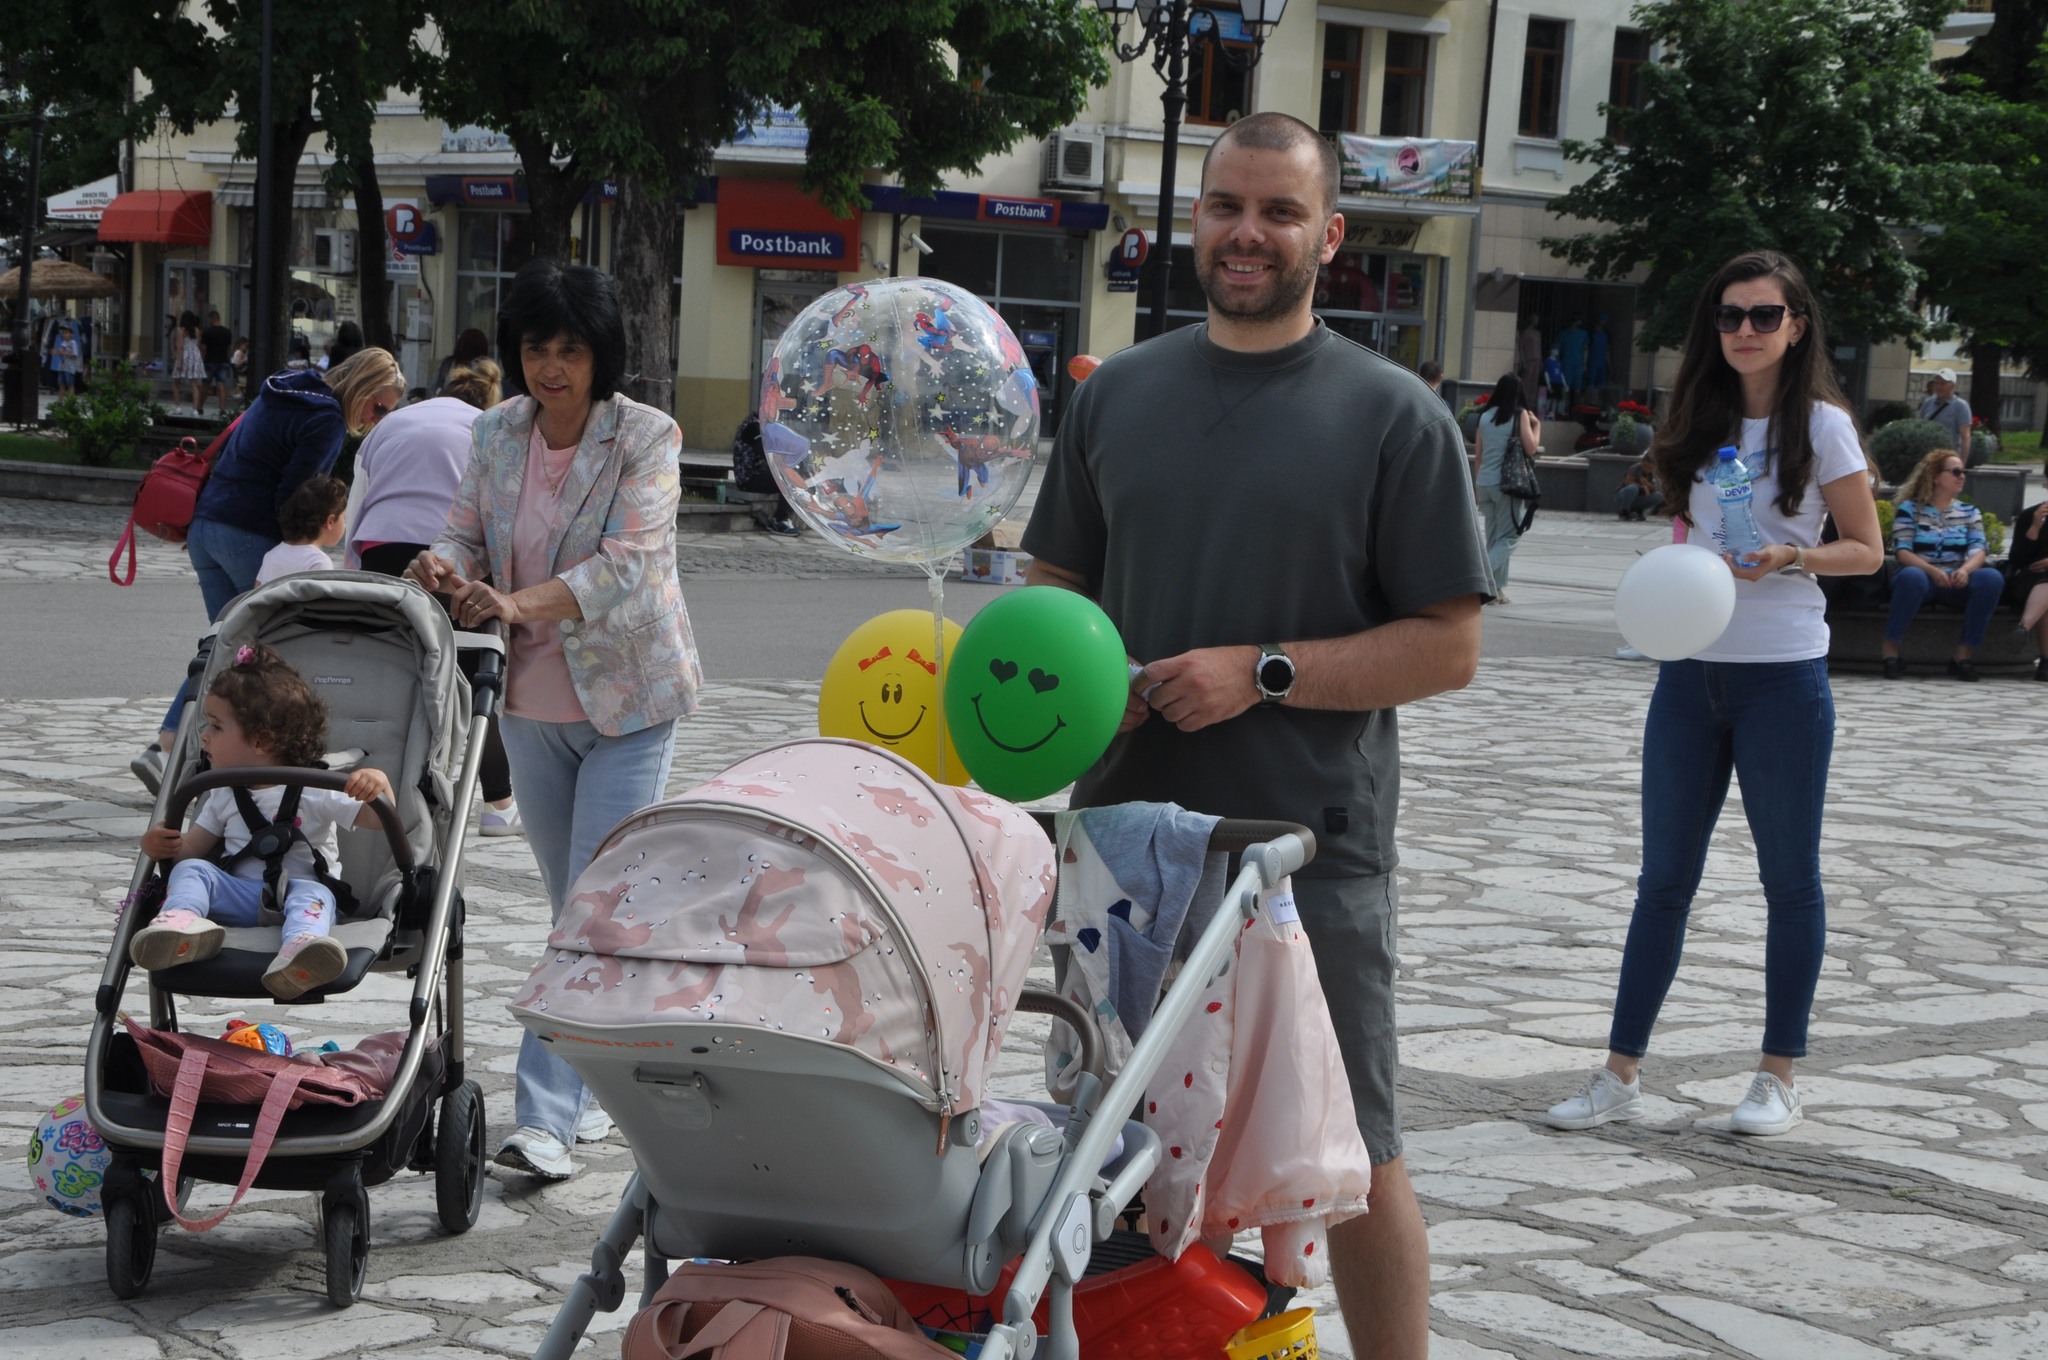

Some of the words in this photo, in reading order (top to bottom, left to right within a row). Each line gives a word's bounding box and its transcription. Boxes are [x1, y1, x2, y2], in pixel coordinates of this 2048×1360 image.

[470, 184, 503, 196] Postbank
[995, 203, 1047, 219] Postbank
[741, 233, 832, 255] Postbank
[1725, 485, 1750, 497] DEVIN
